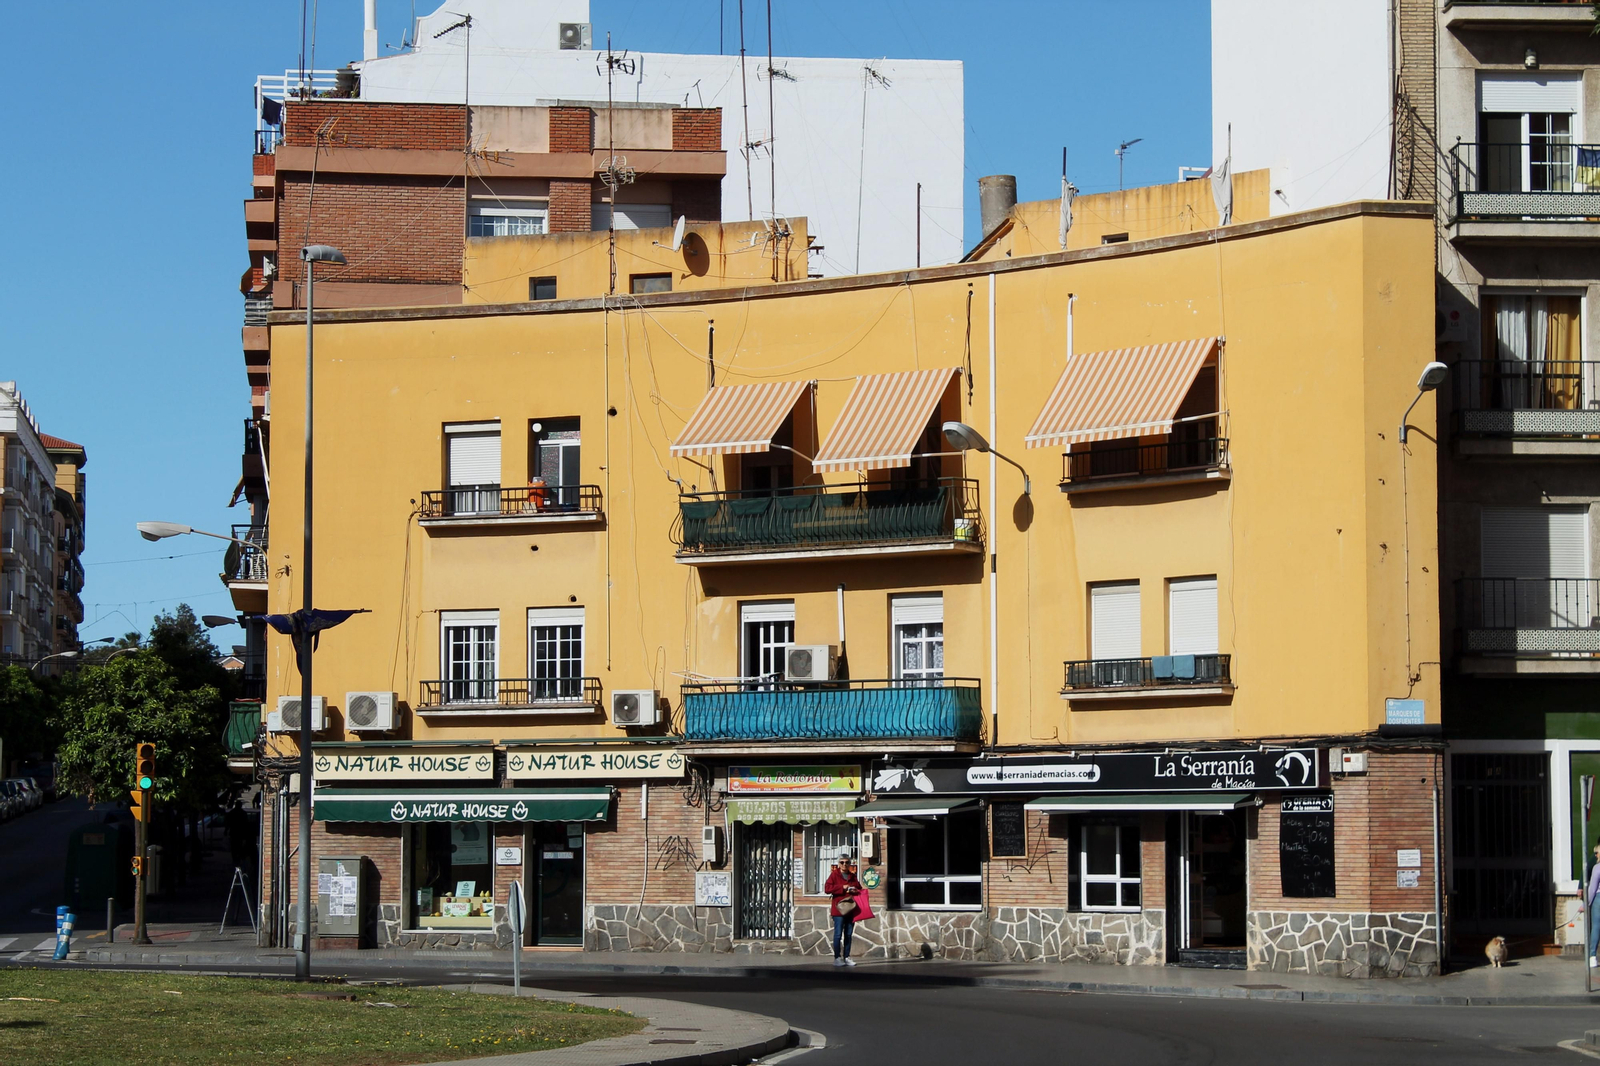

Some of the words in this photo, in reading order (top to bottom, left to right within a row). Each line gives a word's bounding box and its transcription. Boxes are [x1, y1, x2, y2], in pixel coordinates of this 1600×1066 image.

[334, 755, 403, 772] NATUR
[408, 755, 471, 772] HOUSE
[528, 753, 595, 770] NATUR
[600, 753, 662, 770] HOUSE
[1153, 756, 1176, 777] La
[1181, 754, 1255, 777] Serranía
[775, 770, 832, 783] Rotonda
[971, 769, 1096, 781] www.laserraniademacias.com
[1211, 778, 1222, 789] de
[1225, 775, 1255, 789] Macías
[737, 801, 786, 814] TOLDOS
[789, 801, 845, 814] HIDALGO
[1293, 797, 1321, 805] OFERTA
[409, 803, 459, 818] NATUR
[461, 803, 509, 818] HOUSE
